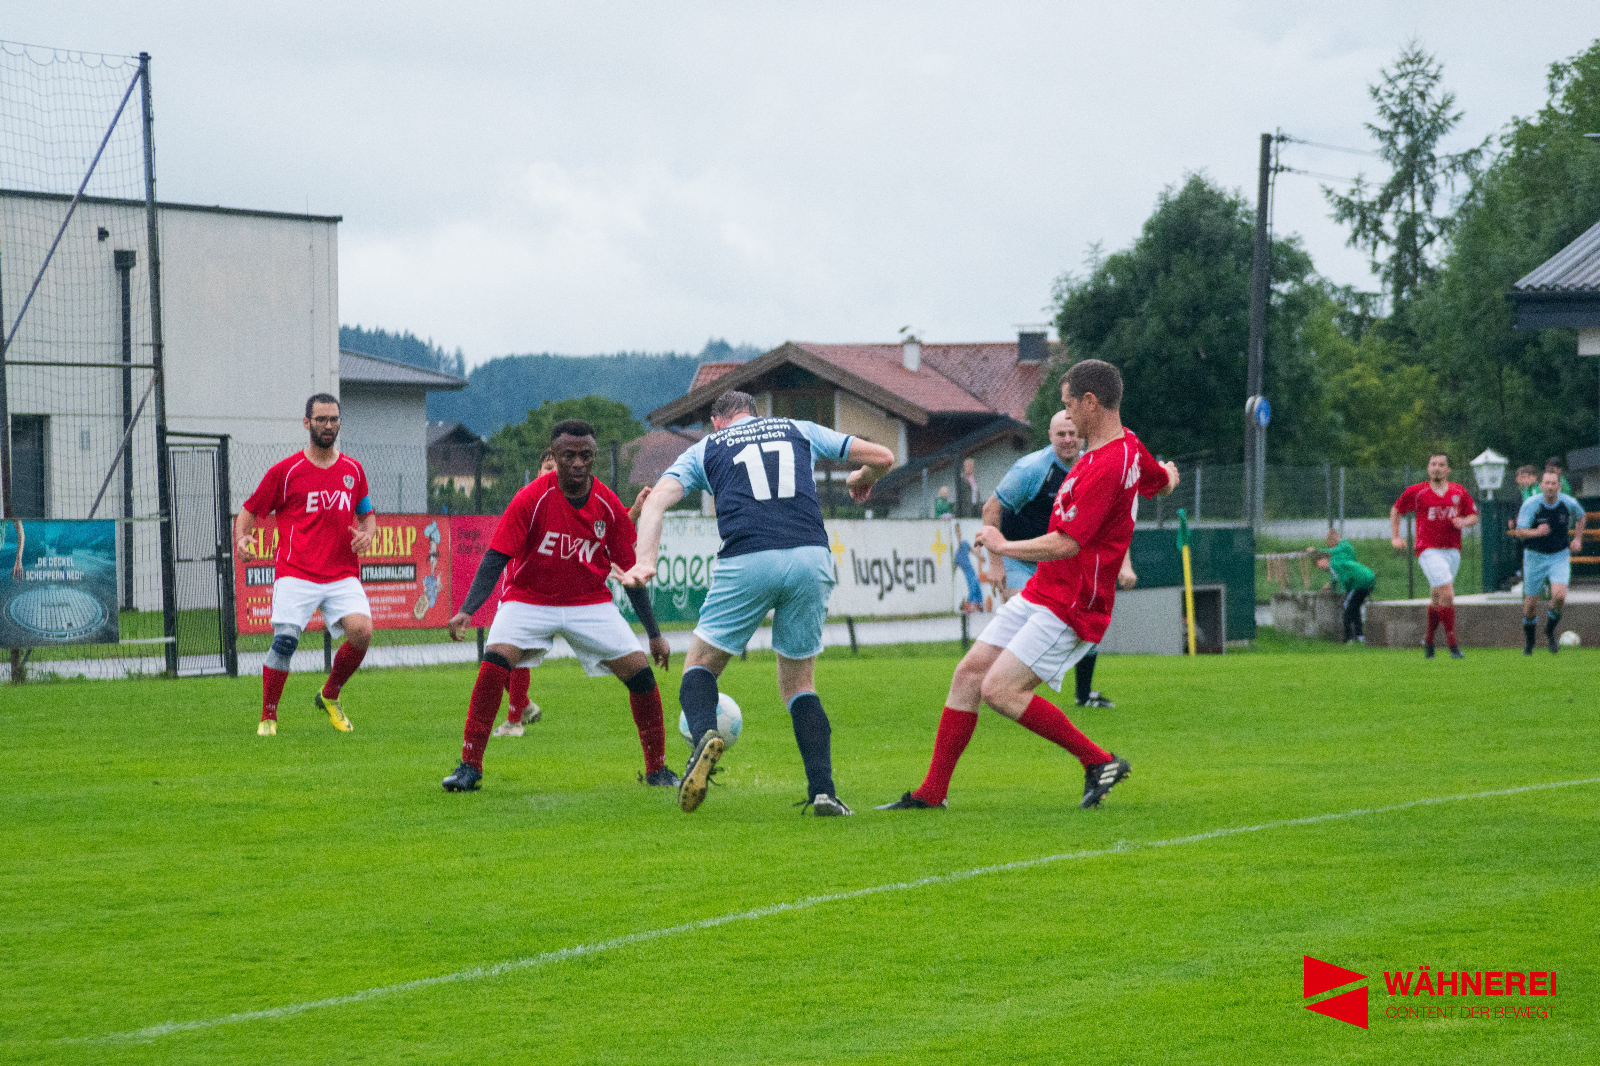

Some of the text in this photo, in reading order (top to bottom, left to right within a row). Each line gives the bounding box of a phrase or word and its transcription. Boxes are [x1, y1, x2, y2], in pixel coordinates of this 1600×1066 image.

[726, 430, 786, 447] Österreich
[732, 440, 796, 501] 17
[305, 490, 352, 513] EVN
[1427, 505, 1459, 520] EVN
[358, 526, 417, 557] EBAP
[537, 531, 601, 564] EVN
[48, 556, 74, 568] DECKEL
[25, 569, 65, 581] SCHEPPERN
